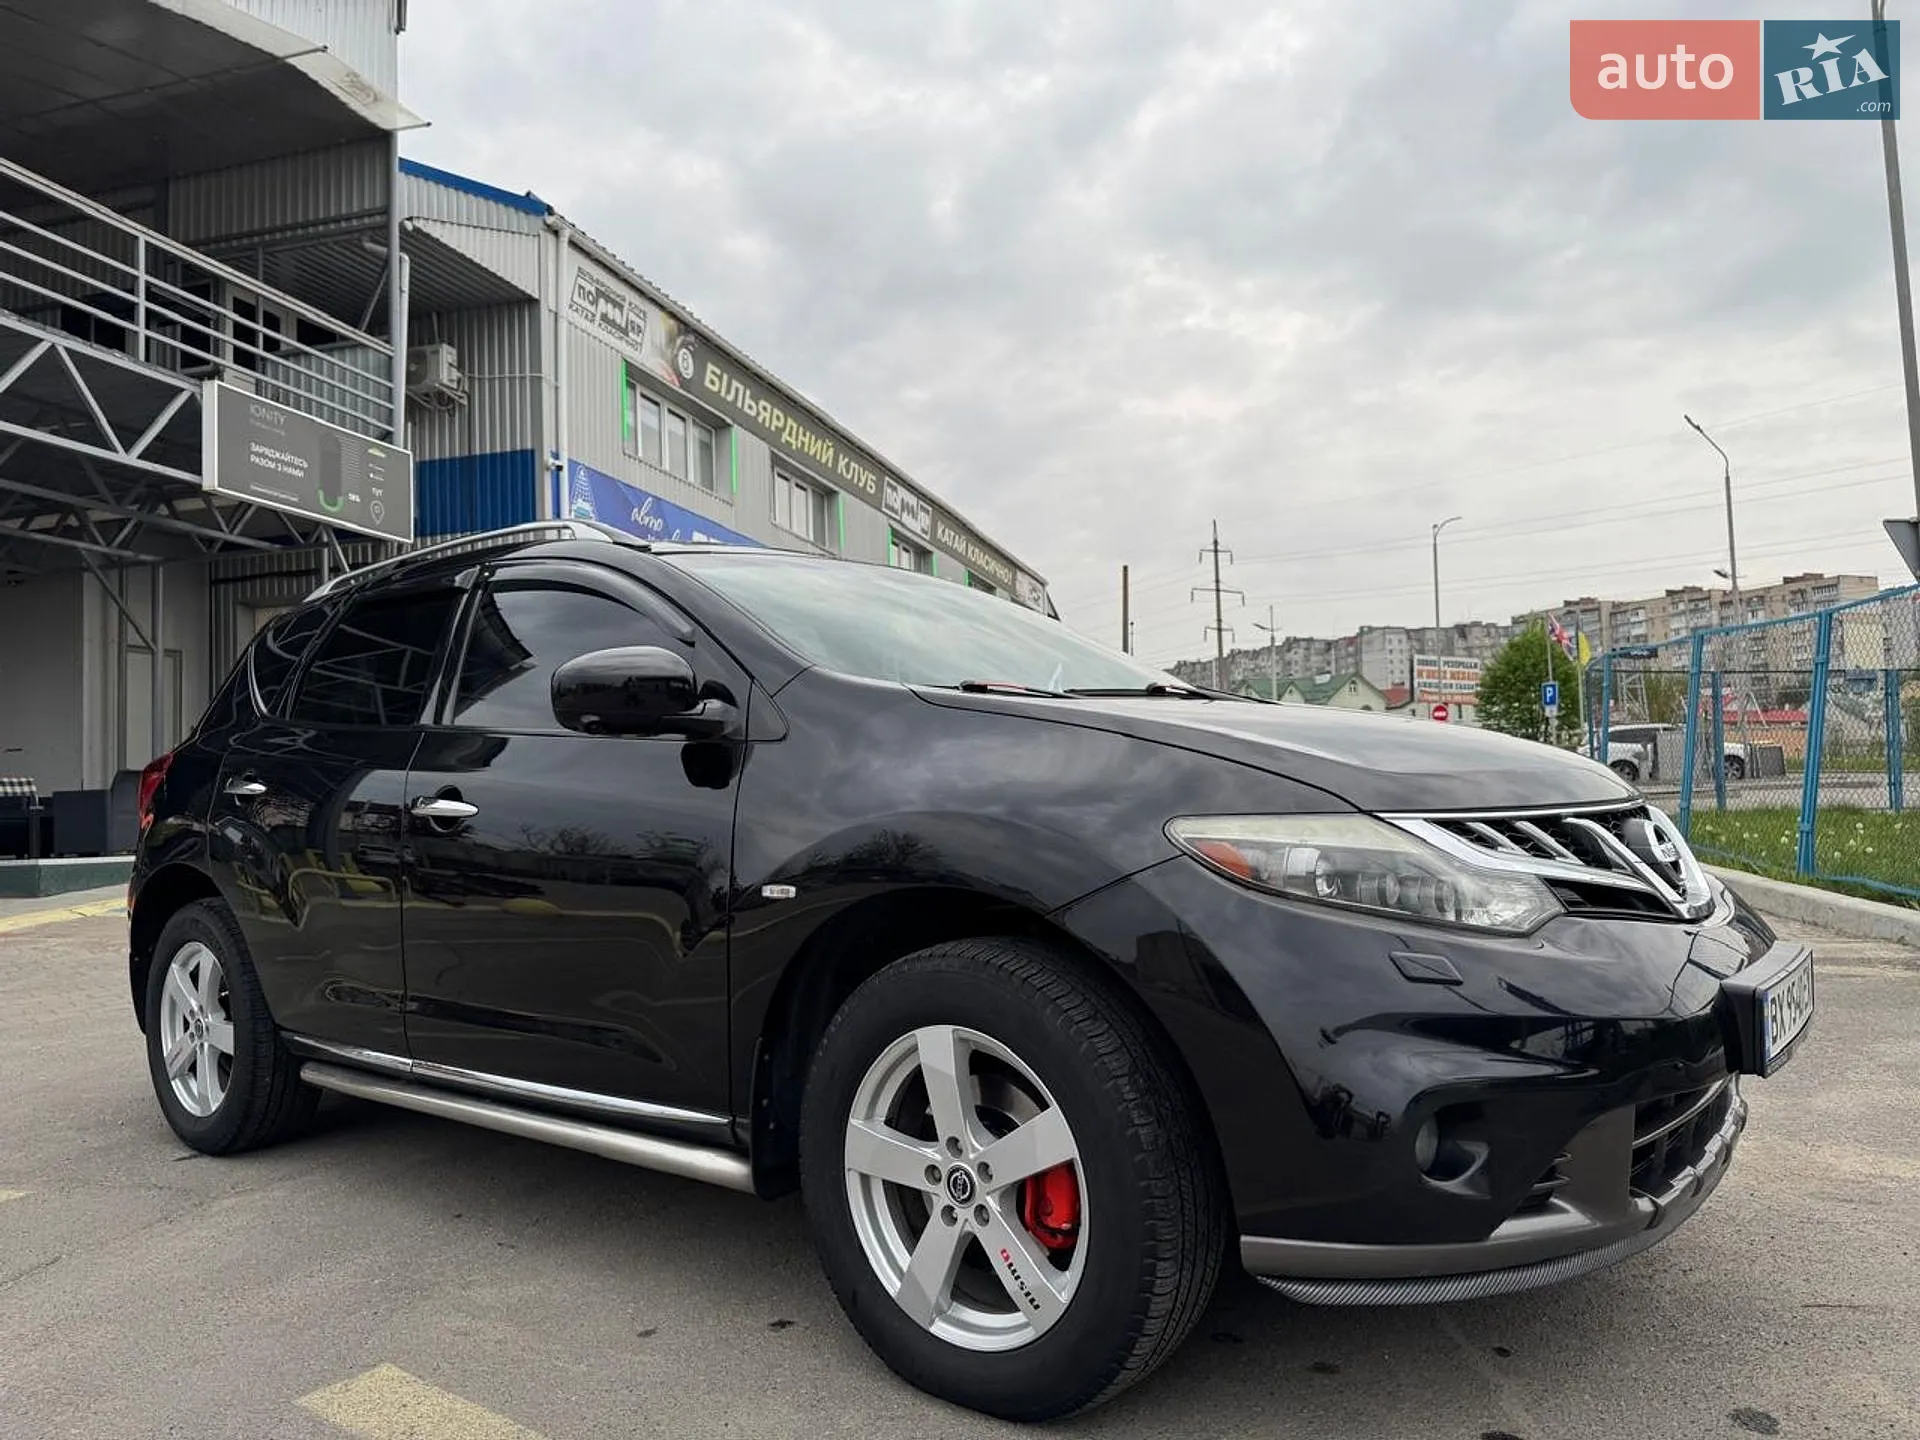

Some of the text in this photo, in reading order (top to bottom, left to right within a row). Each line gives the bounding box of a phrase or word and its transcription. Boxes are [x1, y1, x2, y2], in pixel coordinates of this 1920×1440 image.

[703, 361, 877, 495] БІЛЬЯРДНИЙ КЛУБ
[249, 439, 309, 468] ЗАРЯДЖАЙТЕСЬ
[249, 453, 276, 469] РАЗОМ
[283, 465, 305, 479] НАМИ
[937, 520, 966, 557] КАТАЙ
[1546, 686, 1554, 703] P
